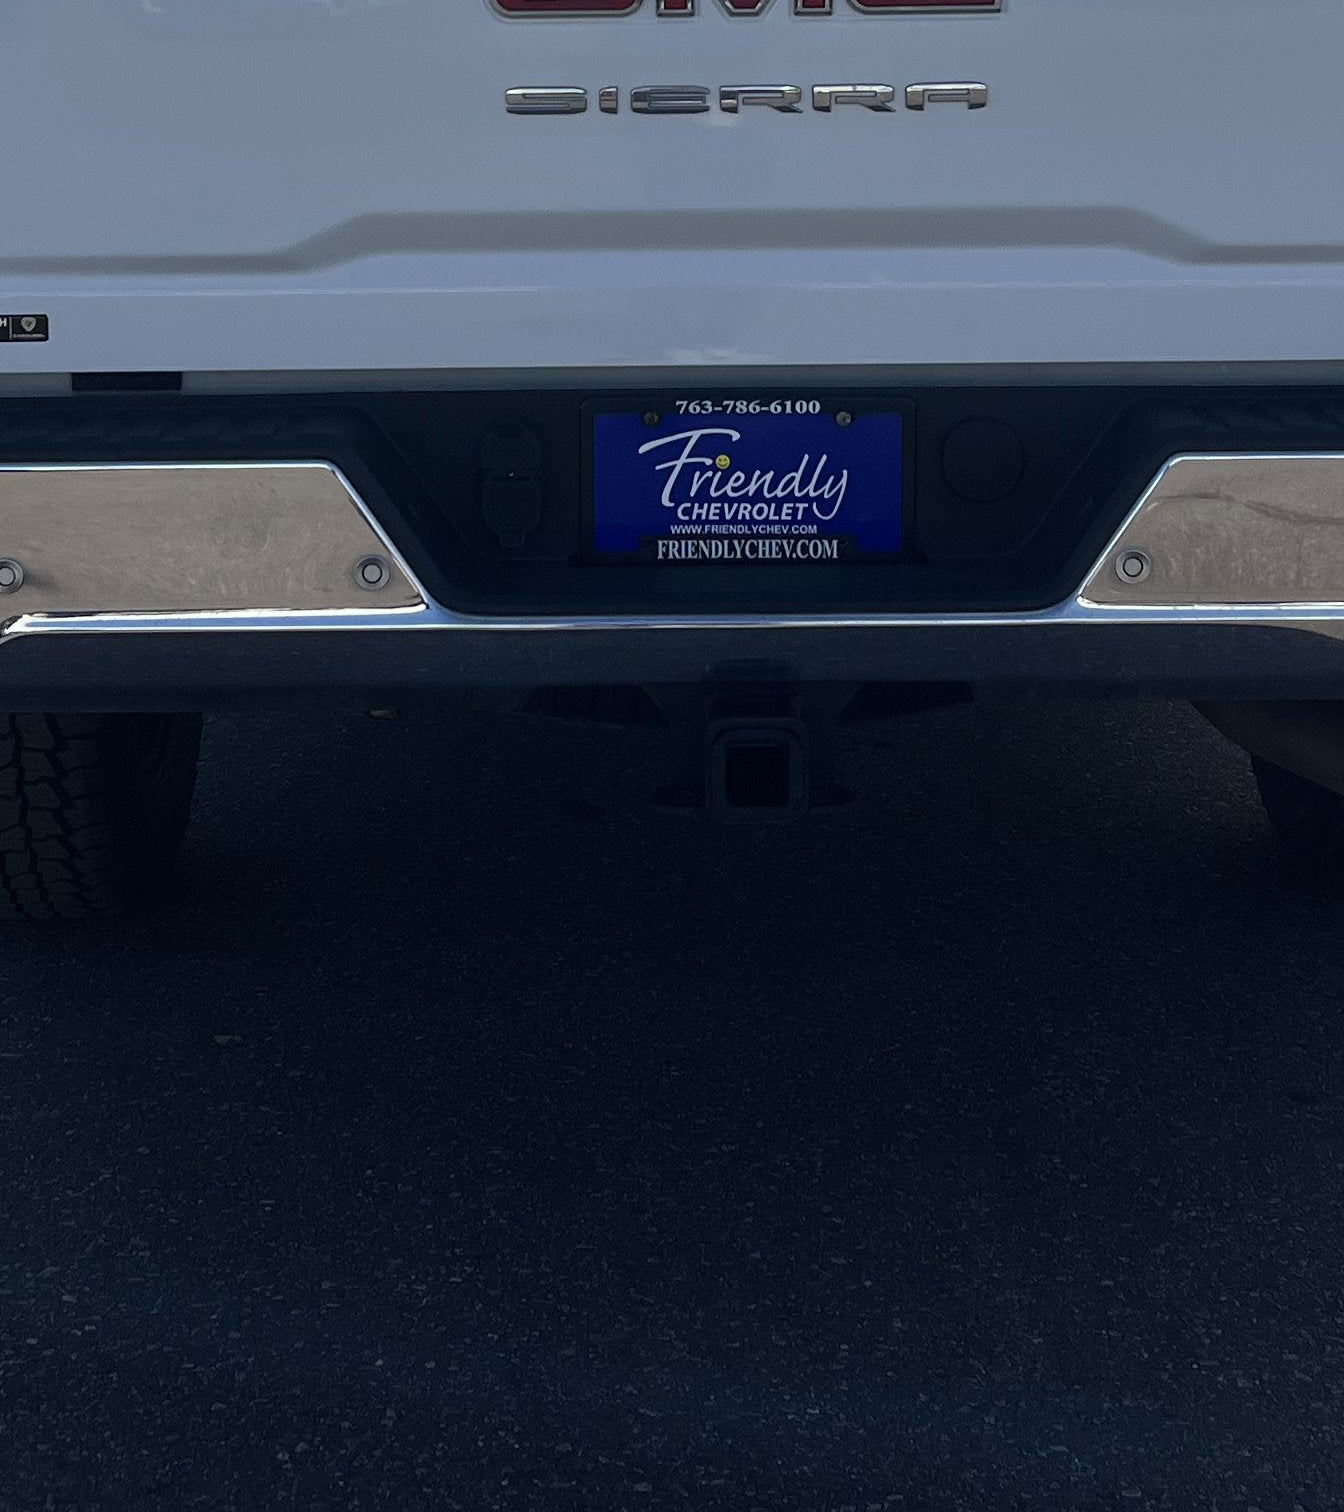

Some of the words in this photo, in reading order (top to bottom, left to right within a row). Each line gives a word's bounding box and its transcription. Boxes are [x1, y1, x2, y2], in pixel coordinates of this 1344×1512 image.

[504, 82, 989, 115] SIERRA
[675, 399, 821, 416] 763-786-6100
[638, 428, 848, 521] Friendly
[677, 502, 809, 521] CHEVROLET
[670, 524, 818, 536] WWW.FRIENDLYCHEV.COM
[657, 539, 839, 560] FRIENDLYCHEV.COM
